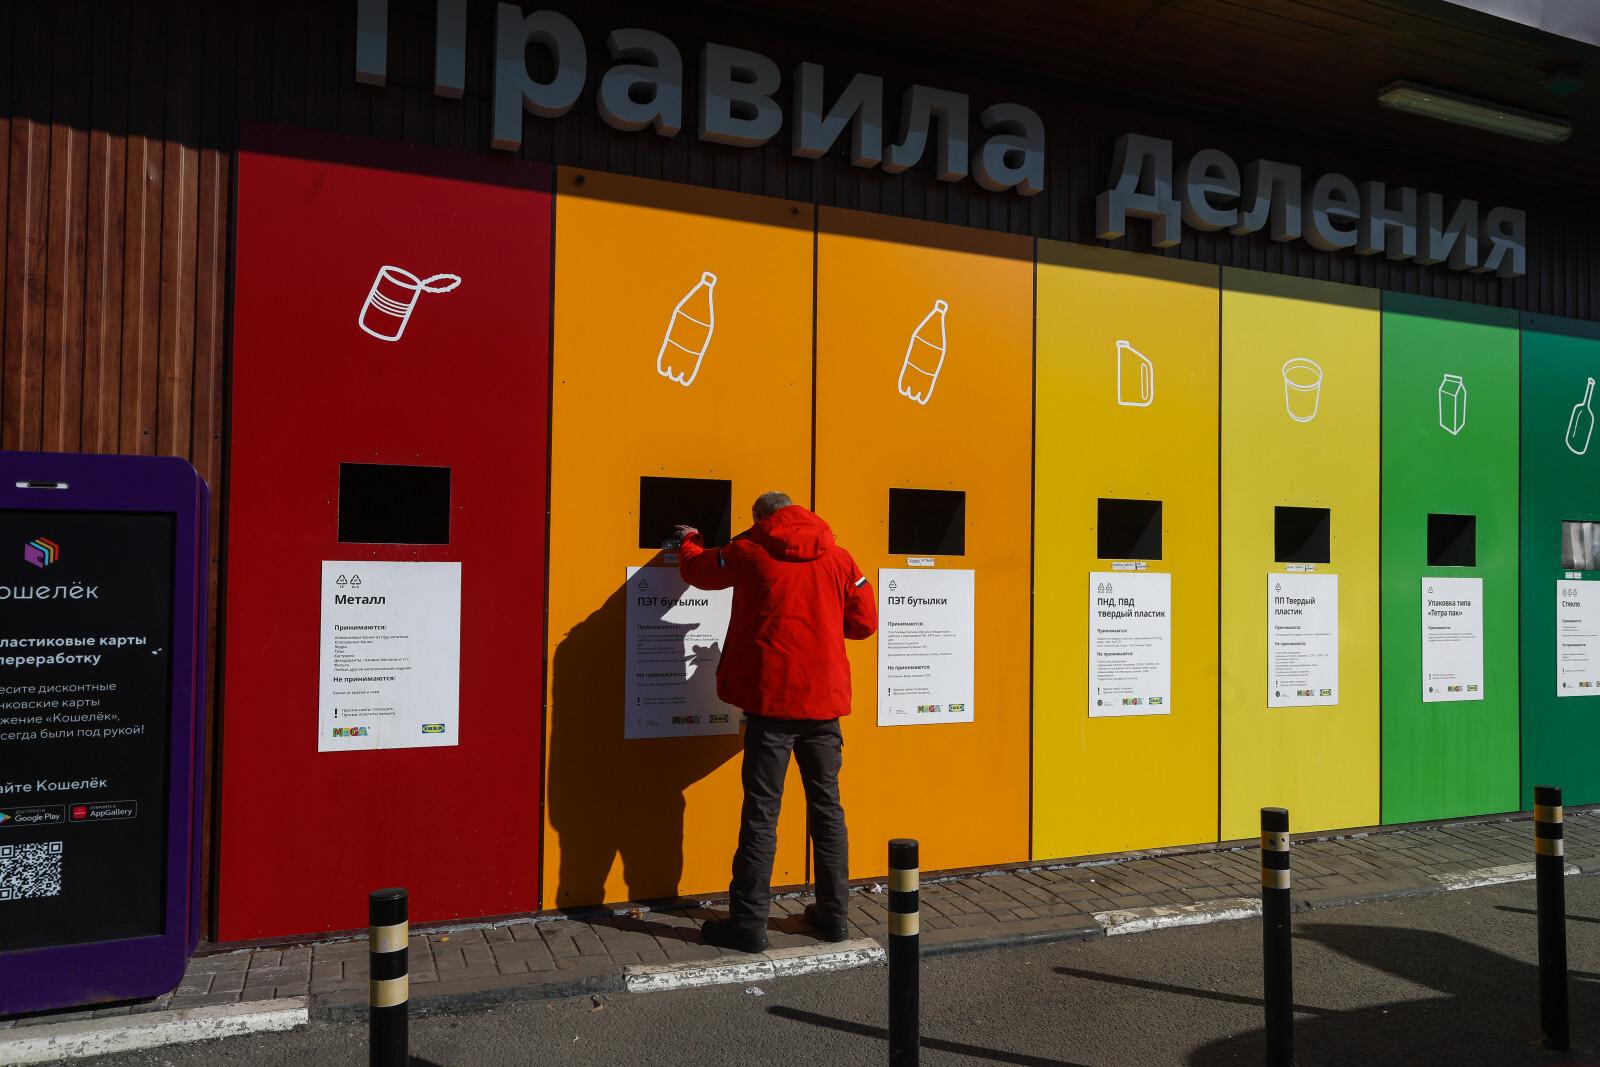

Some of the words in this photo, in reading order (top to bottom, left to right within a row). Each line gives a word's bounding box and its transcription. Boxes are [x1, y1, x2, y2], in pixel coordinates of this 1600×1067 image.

[1096, 132, 1527, 278] деления
[0, 581, 99, 599] ошелёк
[334, 595, 386, 605] Металл
[637, 597, 659, 606] ПЭТ
[660, 597, 708, 608] бутылки
[888, 596, 905, 605] ПЭТ
[907, 596, 947, 607] бутылки
[1097, 598, 1116, 607] ПНД,
[1118, 598, 1135, 607] ПВД
[1286, 597, 1315, 606] Твердый
[1098, 609, 1133, 619] твердый
[1428, 610, 1447, 618] «Тетра
[0, 636, 96, 648] ластиковые
[100, 636, 147, 648] карты
[38, 682, 117, 694] дисконтные
[62, 699, 100, 709] карты
[46, 712, 120, 723] «Кошелёк»,
[41, 729, 74, 739] были
[77, 728, 101, 738] под
[103, 724, 145, 738] рукой!
[333, 726, 368, 737] MEGA
[36, 777, 107, 791] Кошелёк
[14, 814, 43, 822] Google
[45, 812, 60, 821] Play
[90, 808, 132, 818] AppGallery
